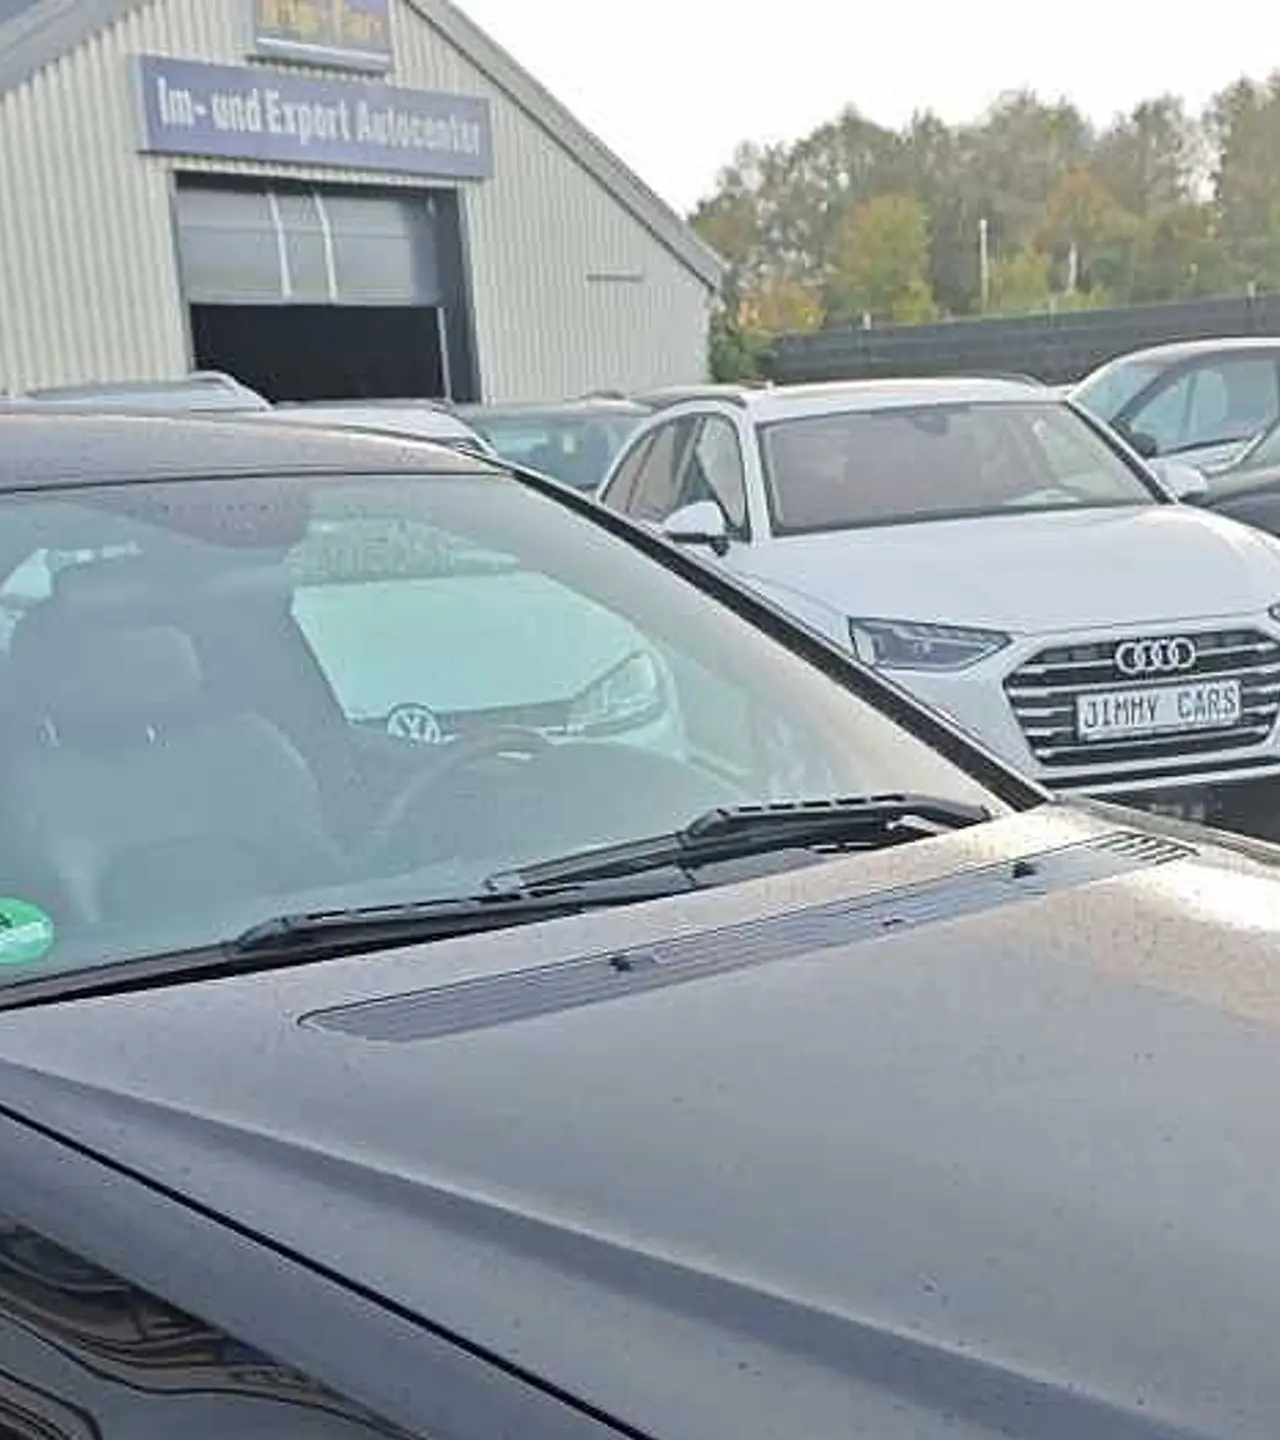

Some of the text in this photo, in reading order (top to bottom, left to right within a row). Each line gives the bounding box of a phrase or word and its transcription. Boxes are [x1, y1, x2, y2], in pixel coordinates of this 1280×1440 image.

[156, 75, 206, 126] Im-
[212, 88, 262, 133] und
[265, 90, 349, 146] Export
[1085, 685, 1236, 728] JIMMY CARS
